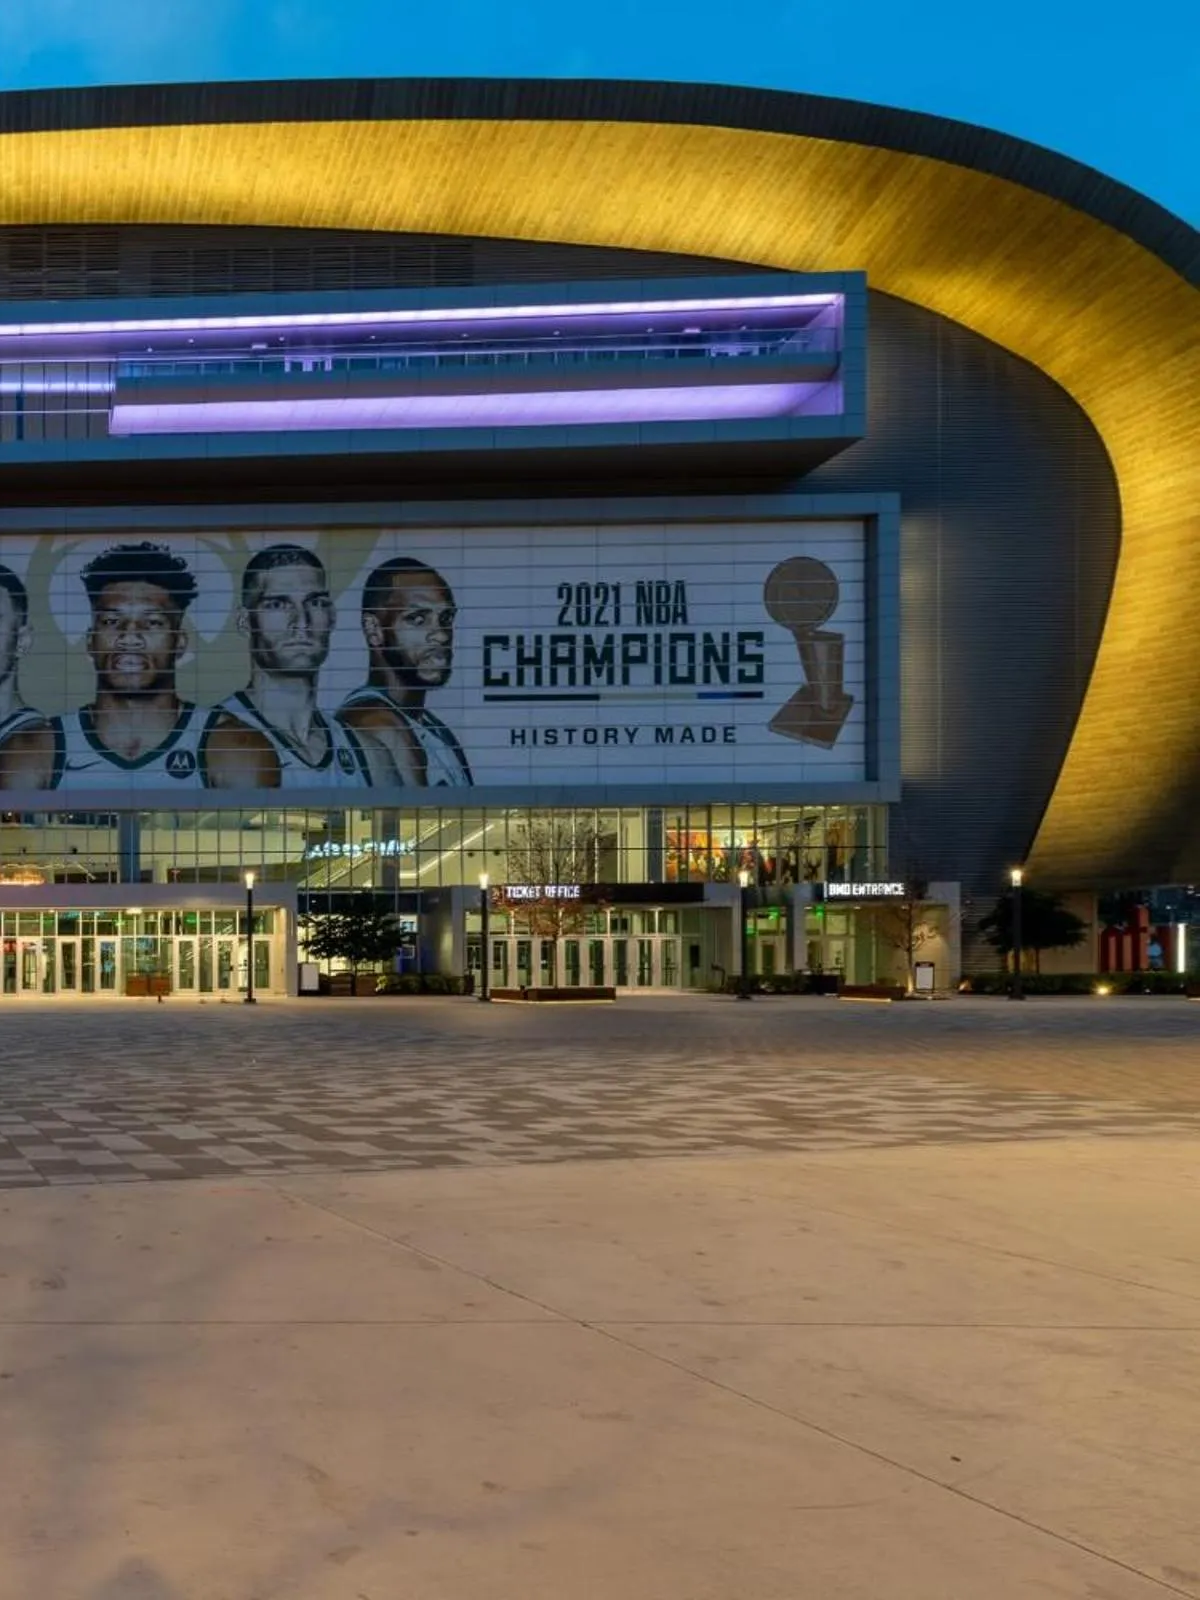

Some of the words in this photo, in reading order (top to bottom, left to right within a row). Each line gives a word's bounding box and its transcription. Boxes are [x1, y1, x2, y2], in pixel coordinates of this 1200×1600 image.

[557, 581, 621, 627] 2021
[636, 579, 689, 626] NBA
[483, 631, 765, 687] CHAMPIONS
[510, 725, 640, 746] HISTORY
[654, 725, 738, 744] MADE
[505, 885, 541, 899] TICKET
[544, 884, 581, 899] OFFICE
[852, 882, 905, 896] ENTRANCE
